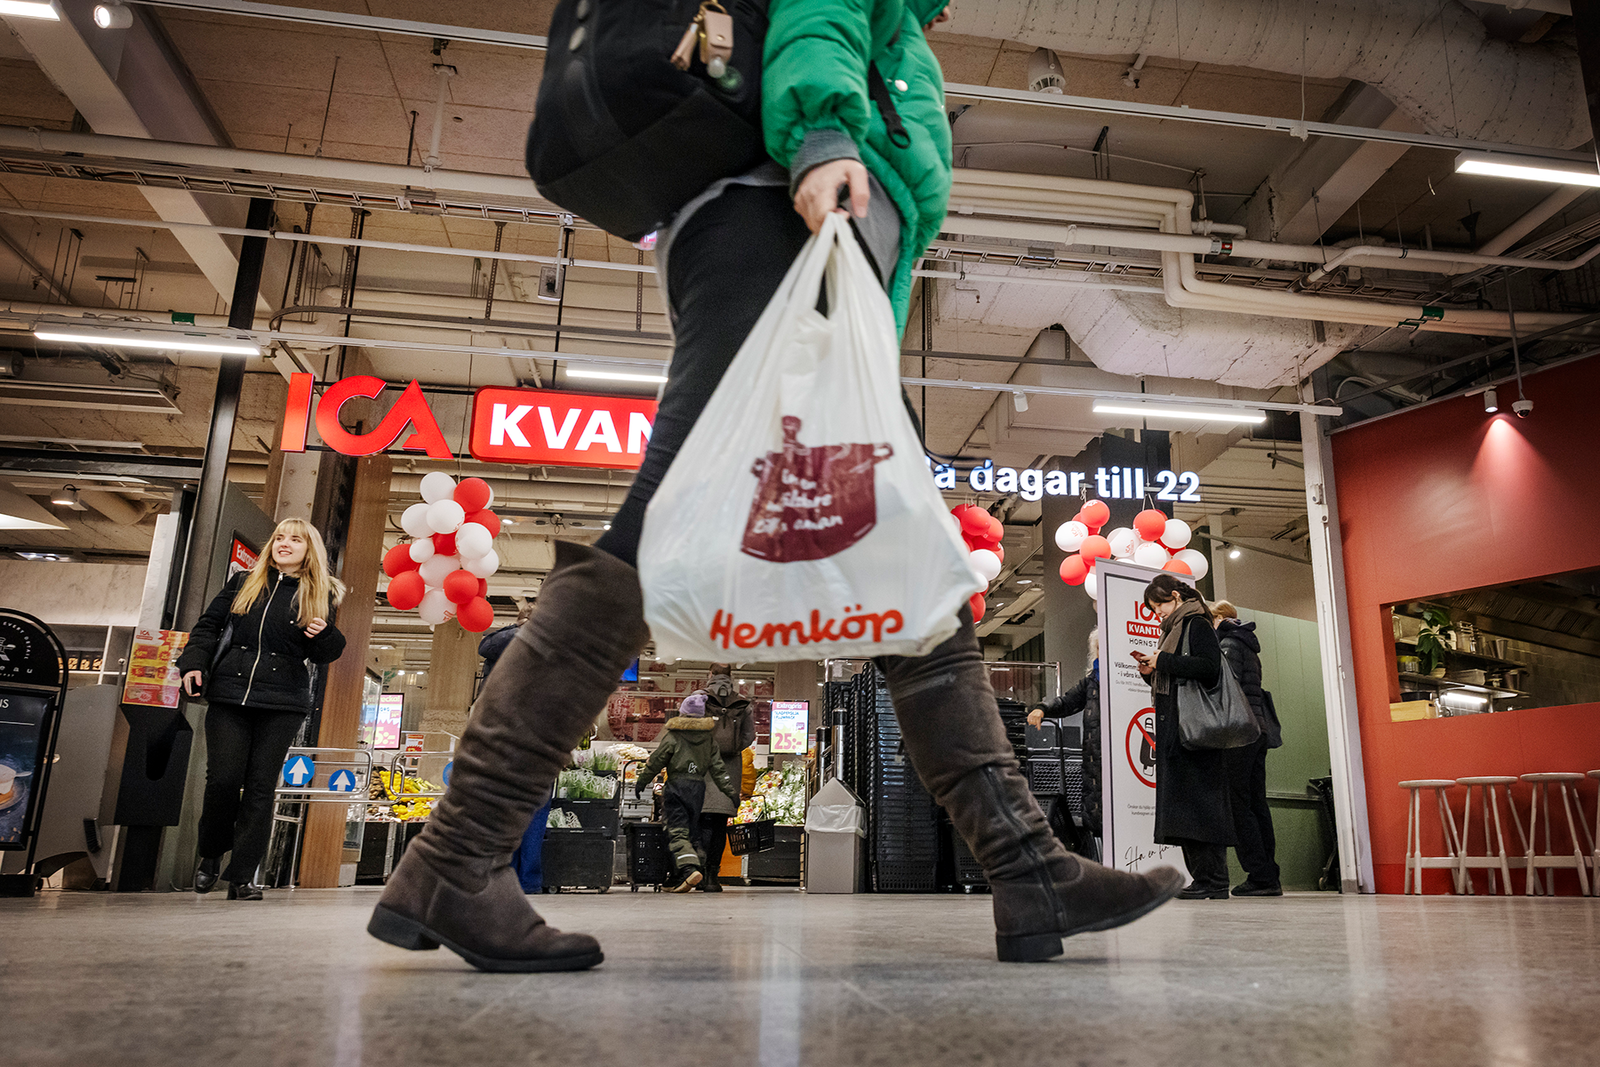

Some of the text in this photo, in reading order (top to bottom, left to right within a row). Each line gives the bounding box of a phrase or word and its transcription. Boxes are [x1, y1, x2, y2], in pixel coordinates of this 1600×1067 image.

[280, 372, 454, 460] ICA
[969, 459, 1085, 501] dagar
[1095, 466, 1145, 499] till
[1156, 470, 1201, 501] 22
[3, 621, 25, 634] EVERY
[709, 604, 904, 650] Hemköp
[774, 732, 802, 750] 25:-
